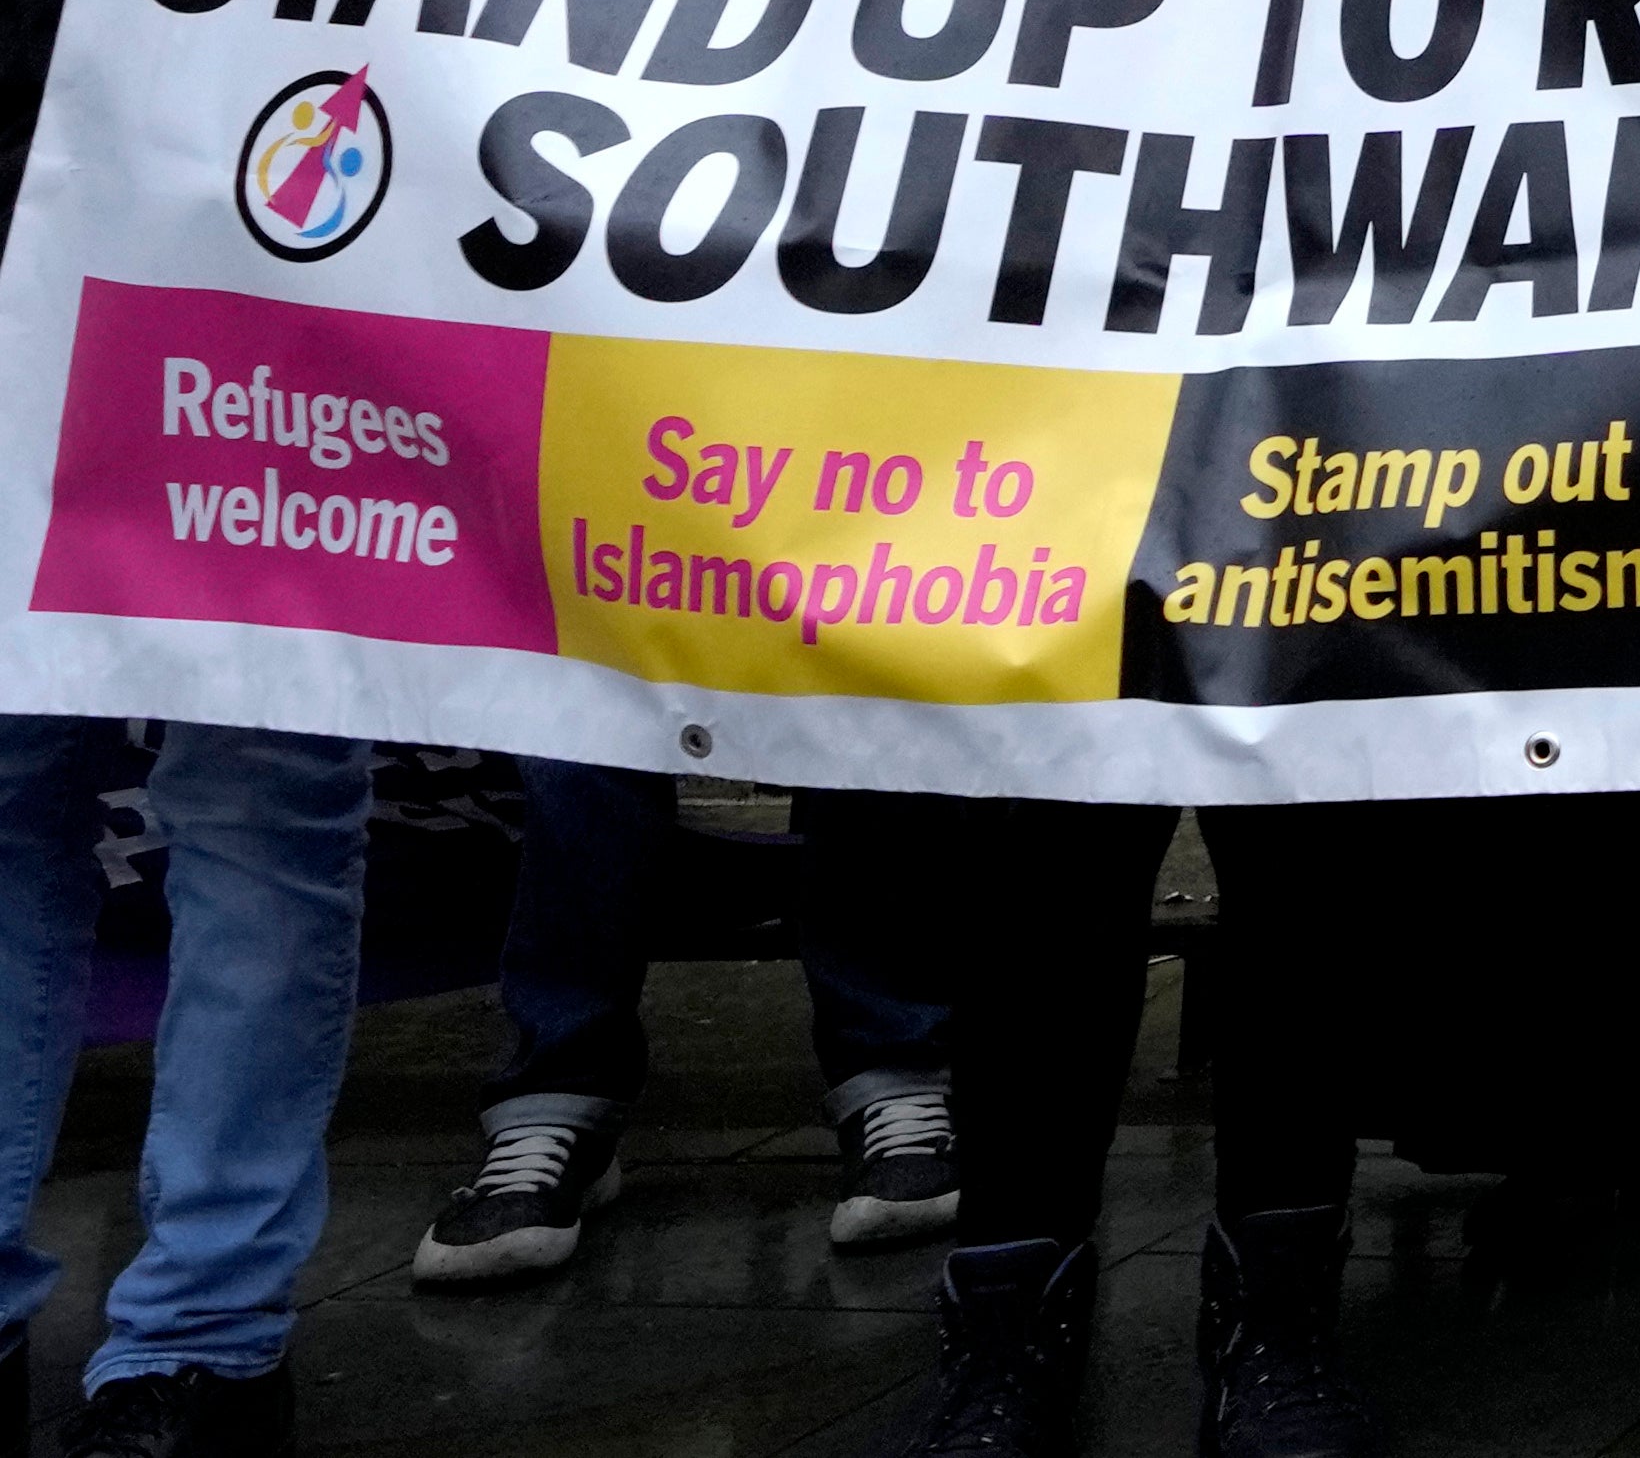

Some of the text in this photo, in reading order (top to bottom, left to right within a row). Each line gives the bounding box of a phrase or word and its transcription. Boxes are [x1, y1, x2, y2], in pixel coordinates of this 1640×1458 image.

[163, 358, 449, 469] Refugees
[166, 468, 457, 566] welcome
[642, 416, 1033, 528] Say no to
[1240, 421, 1632, 528] Stamp out
[570, 516, 1086, 645] Islamophobia
